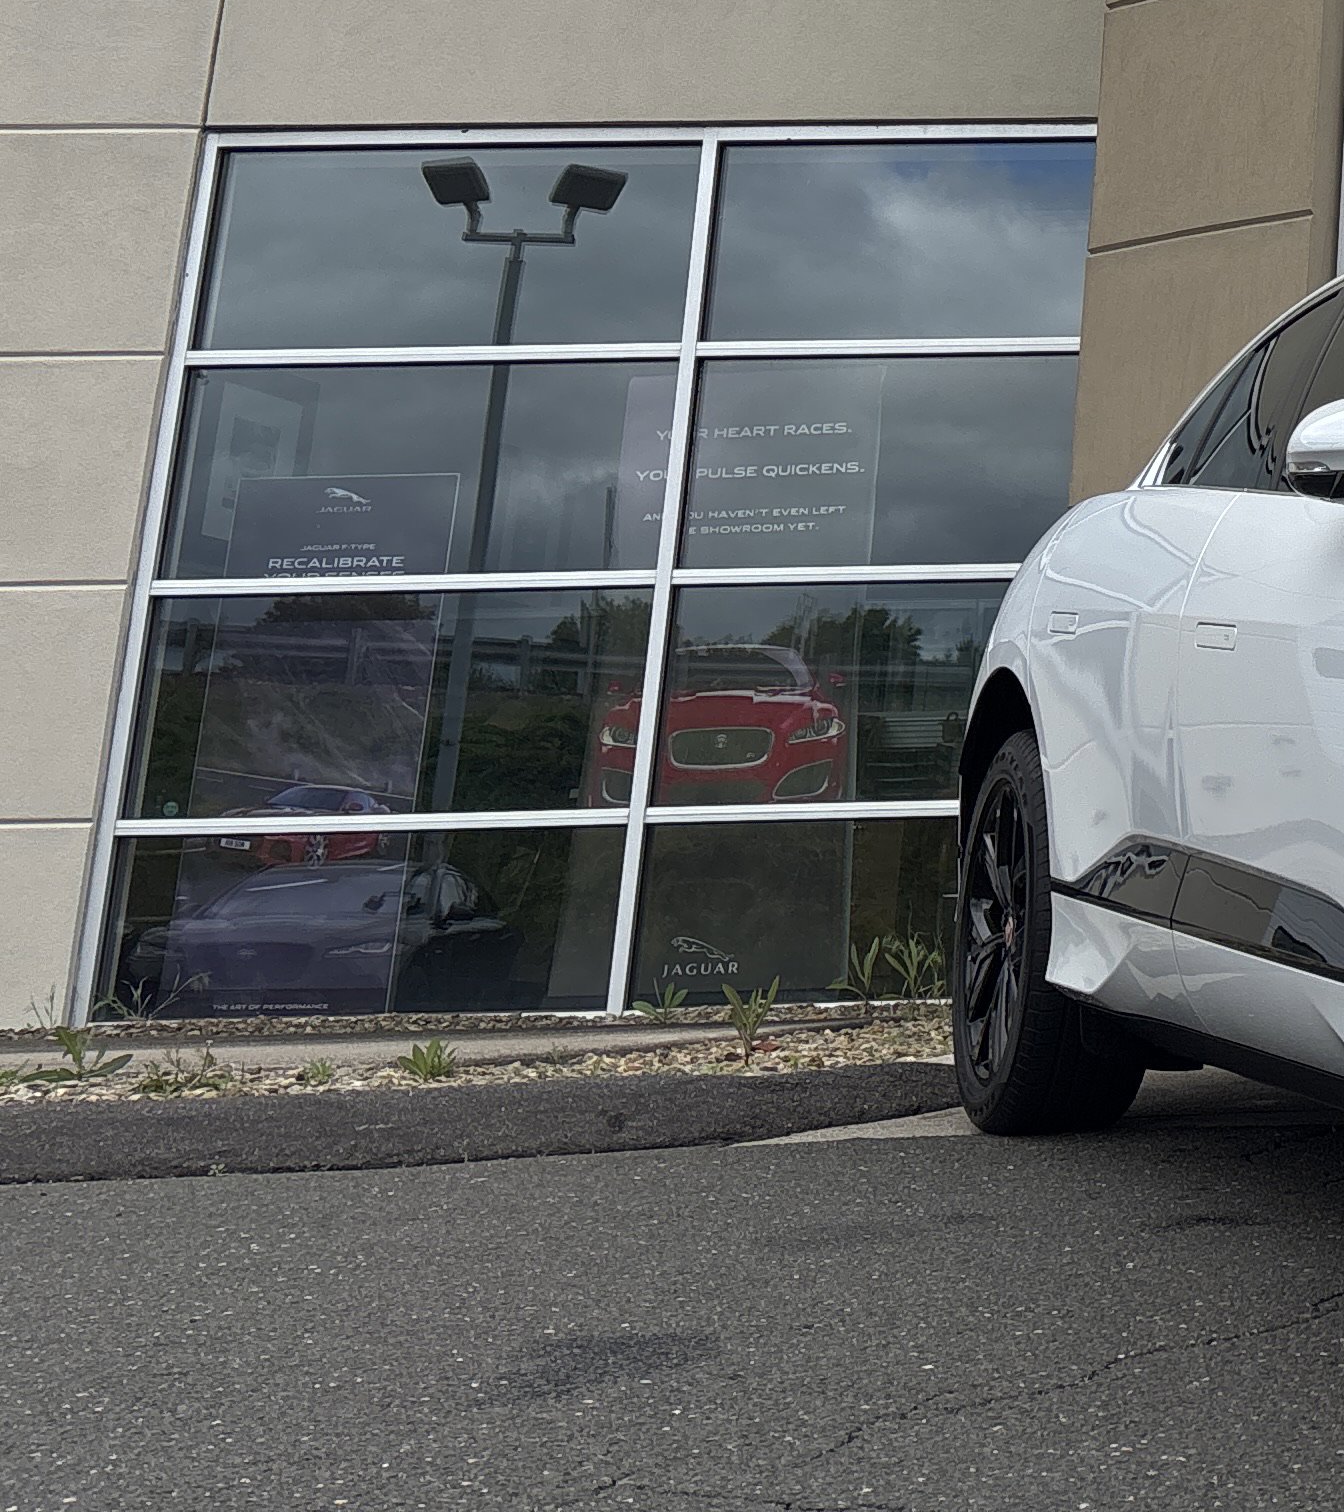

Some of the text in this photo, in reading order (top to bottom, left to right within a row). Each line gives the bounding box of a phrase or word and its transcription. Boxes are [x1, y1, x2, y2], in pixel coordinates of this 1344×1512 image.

[714, 426, 779, 438] HEART
[784, 422, 852, 436] RACES.
[696, 466, 758, 479] PULSE
[763, 461, 865, 477] QUICKENS.
[316, 505, 372, 513] JAGUAR
[708, 508, 769, 519] HAVEN'T
[772, 506, 809, 517] EVEN
[812, 505, 847, 515] LEFT
[700, 523, 784, 534] SHOWROOM
[788, 521, 820, 531] YET.
[267, 556, 406, 569] RECALIBRATE
[661, 962, 739, 978] JAGUAR
